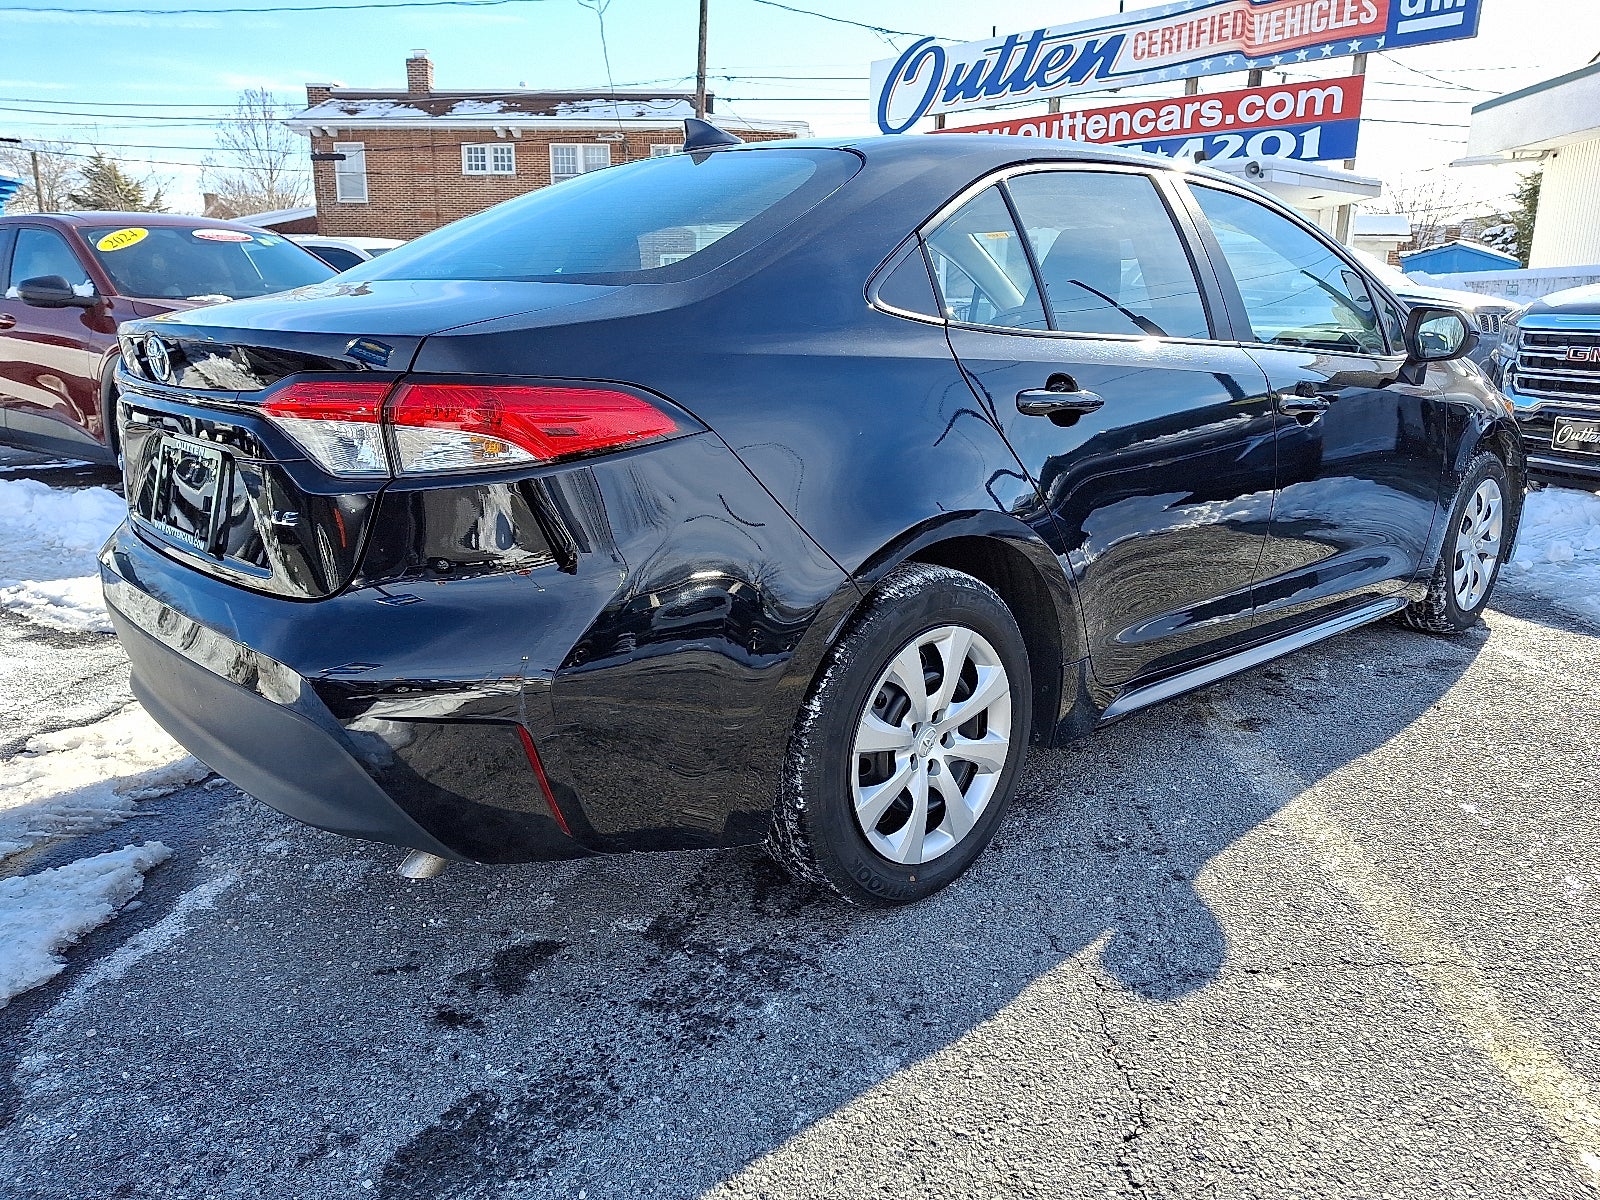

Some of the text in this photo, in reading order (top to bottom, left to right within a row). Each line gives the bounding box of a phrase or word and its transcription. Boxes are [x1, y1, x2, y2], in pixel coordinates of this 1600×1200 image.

[878, 0, 1378, 135] Outten CERTIFIED VEHICLES
[969, 85, 1344, 142] outtencars.com
[104, 230, 138, 249] 2024
[1556, 424, 1600, 444] Outte
[270, 510, 299, 527] LE
